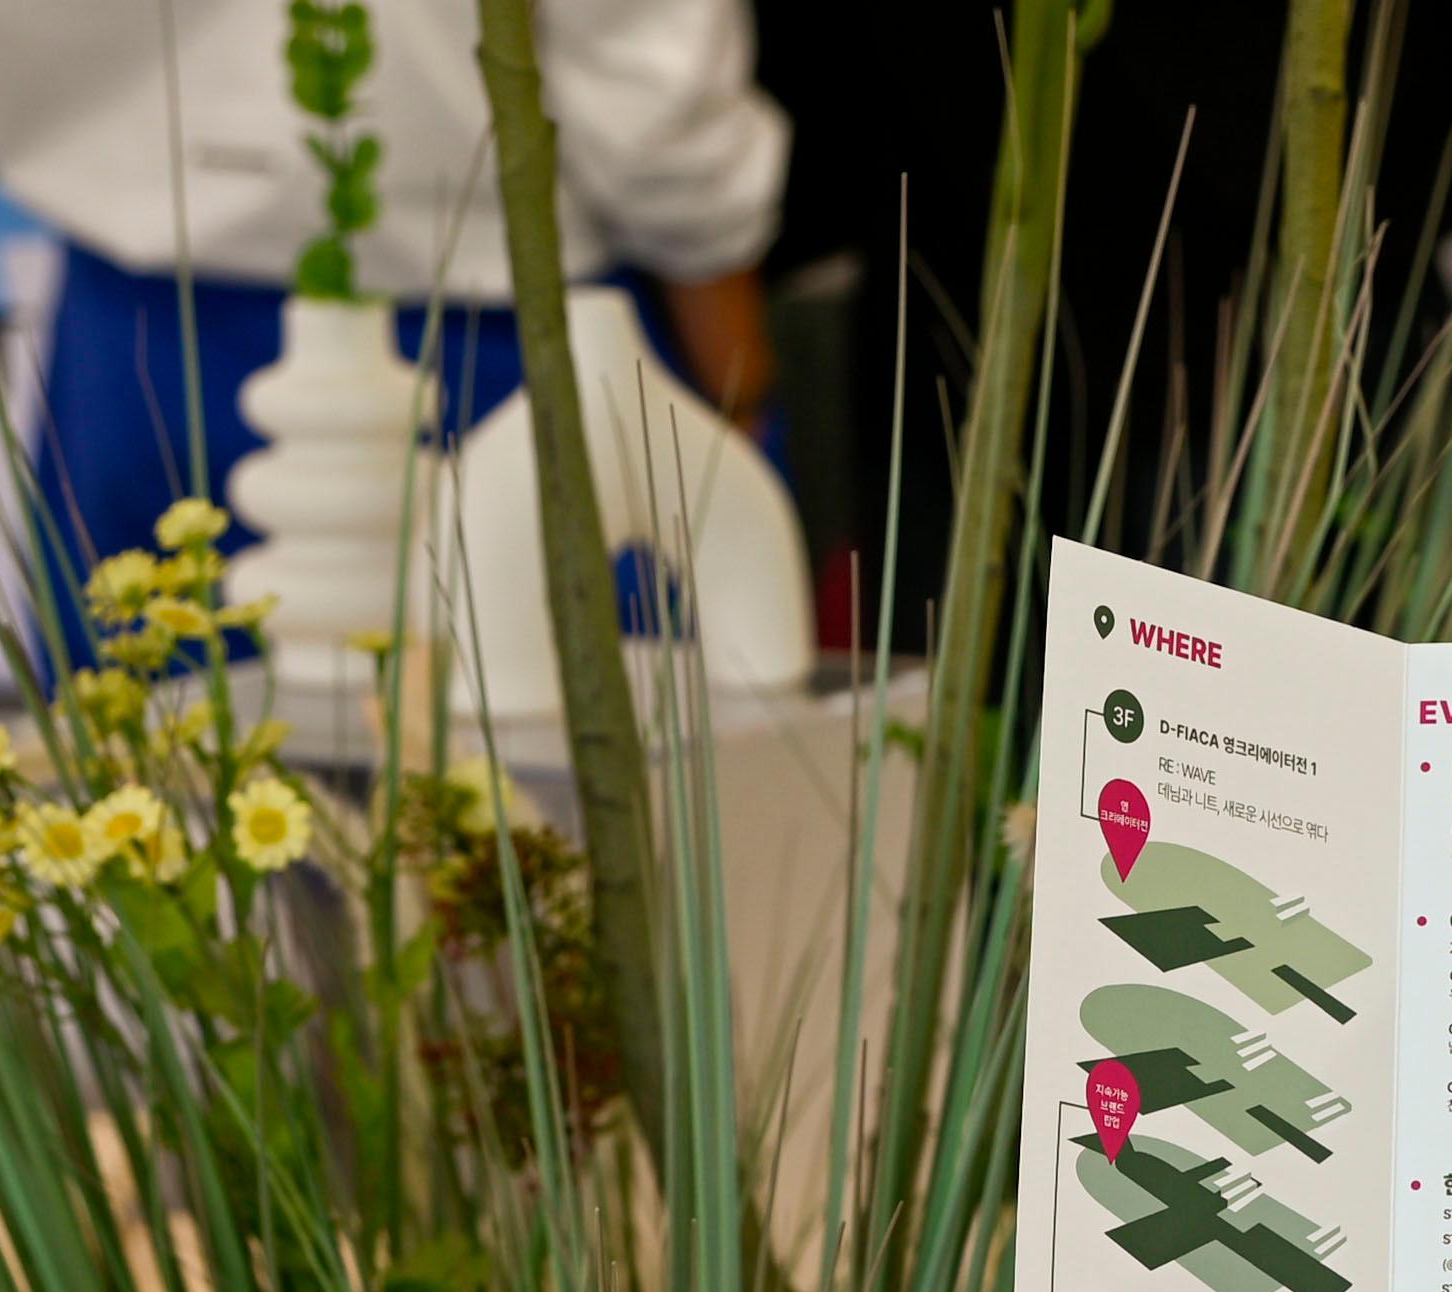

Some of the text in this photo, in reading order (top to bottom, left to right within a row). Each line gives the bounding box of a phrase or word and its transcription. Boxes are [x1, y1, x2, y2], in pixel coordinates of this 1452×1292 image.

[1130, 618, 1222, 669] WHERE
[1113, 706, 1135, 729] 3F
[1158, 756, 1216, 785] RE WAVE
[1159, 719, 1317, 776] D-FIACA 영크리에이터전 1
[1157, 782, 1193, 807] 데님과
[1222, 803, 1257, 824] 새로운
[1259, 809, 1304, 836] 시선으로
